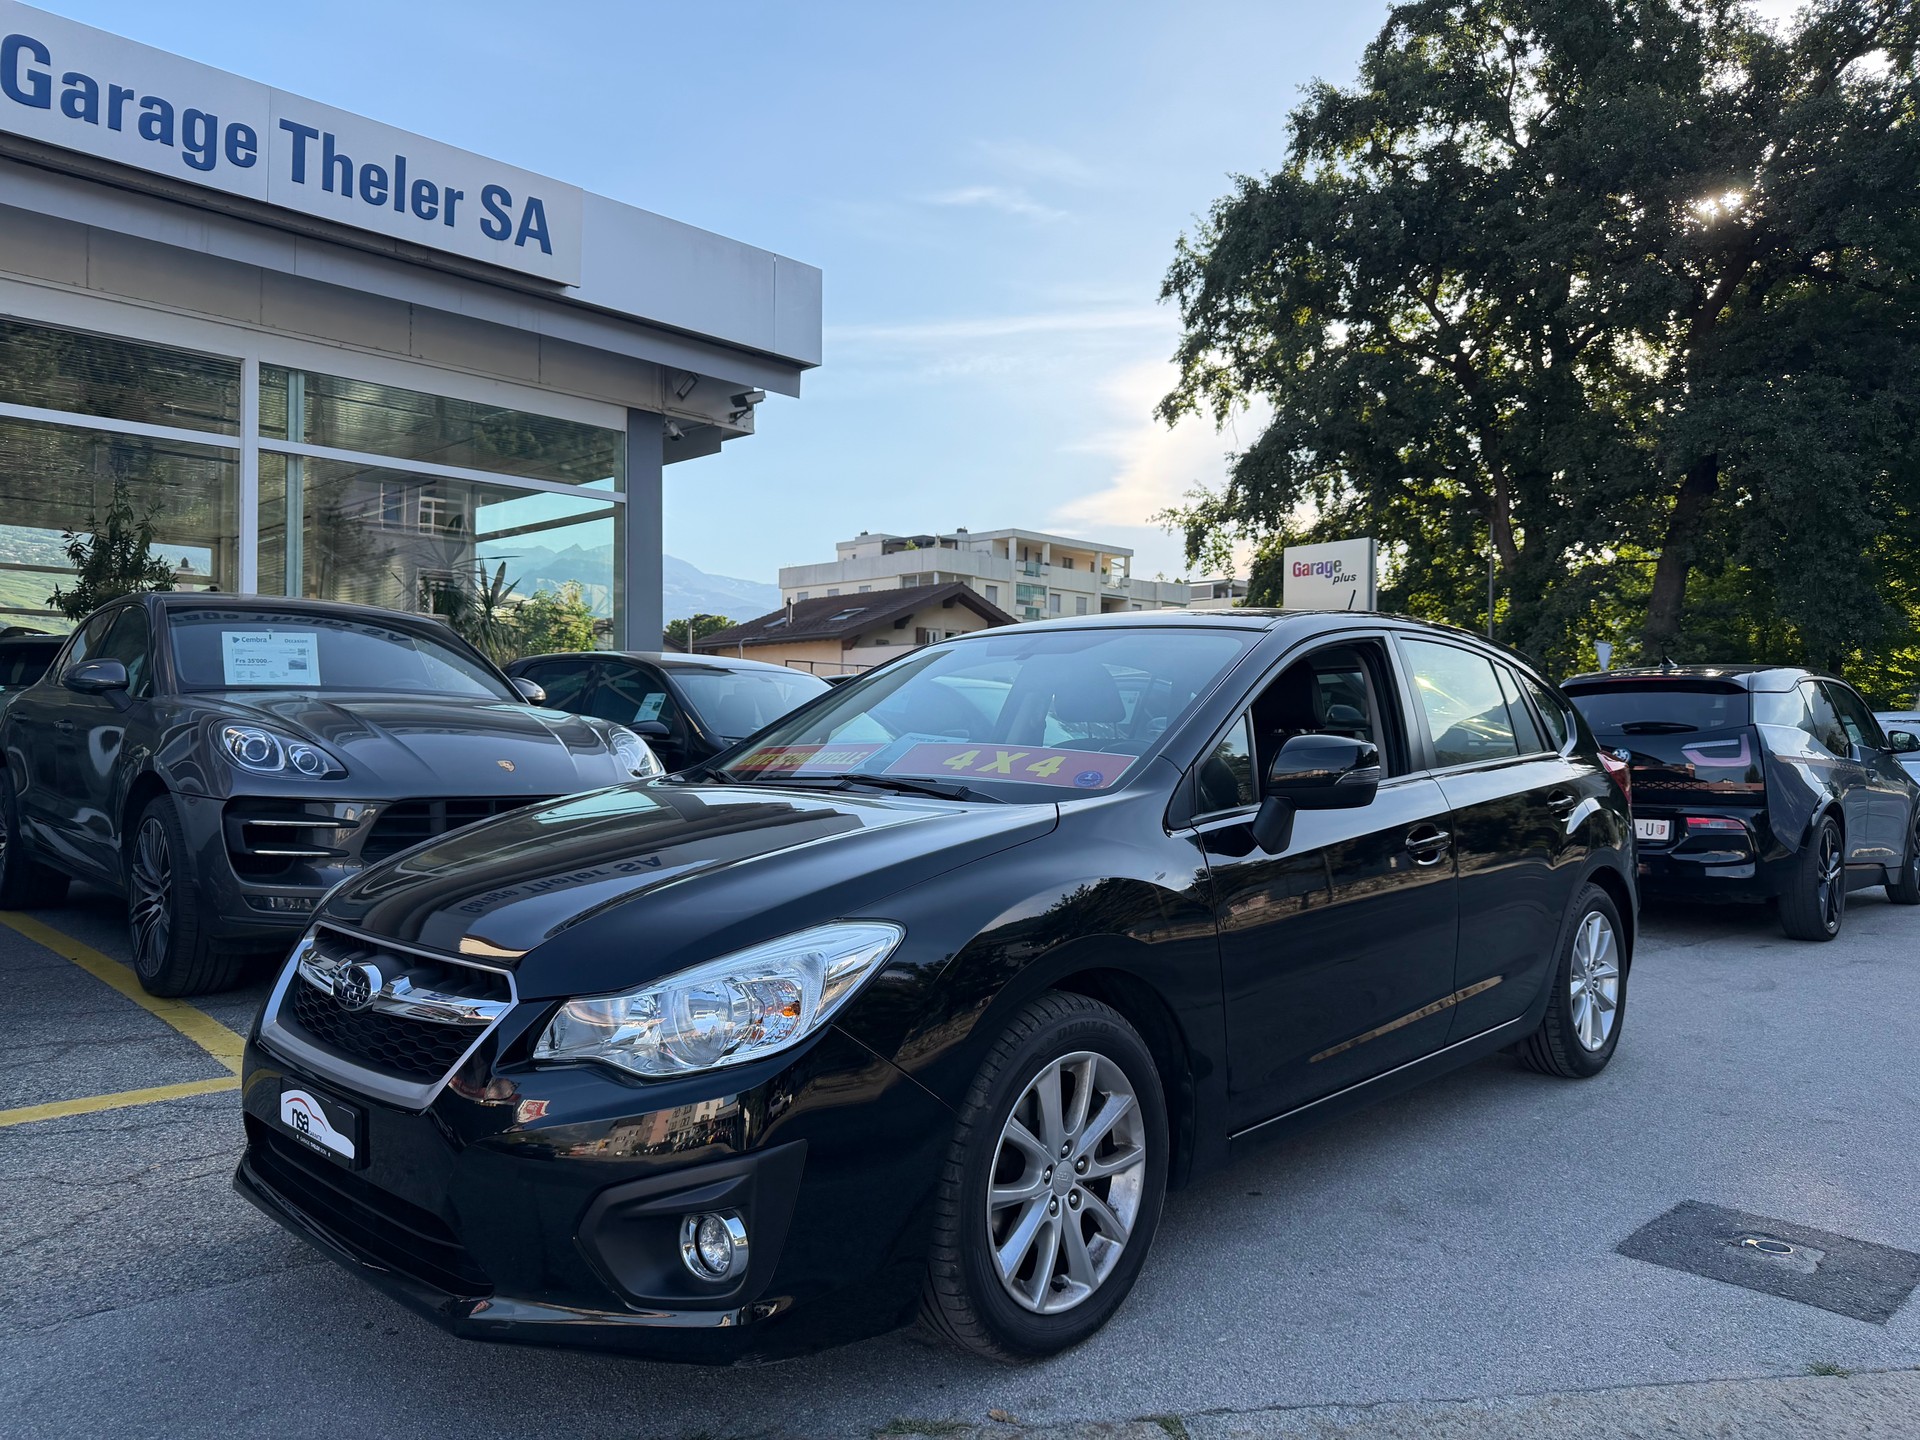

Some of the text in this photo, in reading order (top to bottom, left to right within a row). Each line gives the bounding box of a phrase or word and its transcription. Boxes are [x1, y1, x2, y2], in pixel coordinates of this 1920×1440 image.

[0, 33, 553, 255] Garage Theler SA
[1292, 560, 1342, 579] Garage
[1332, 573, 1357, 586] plus
[291, 1107, 309, 1134] nsa
